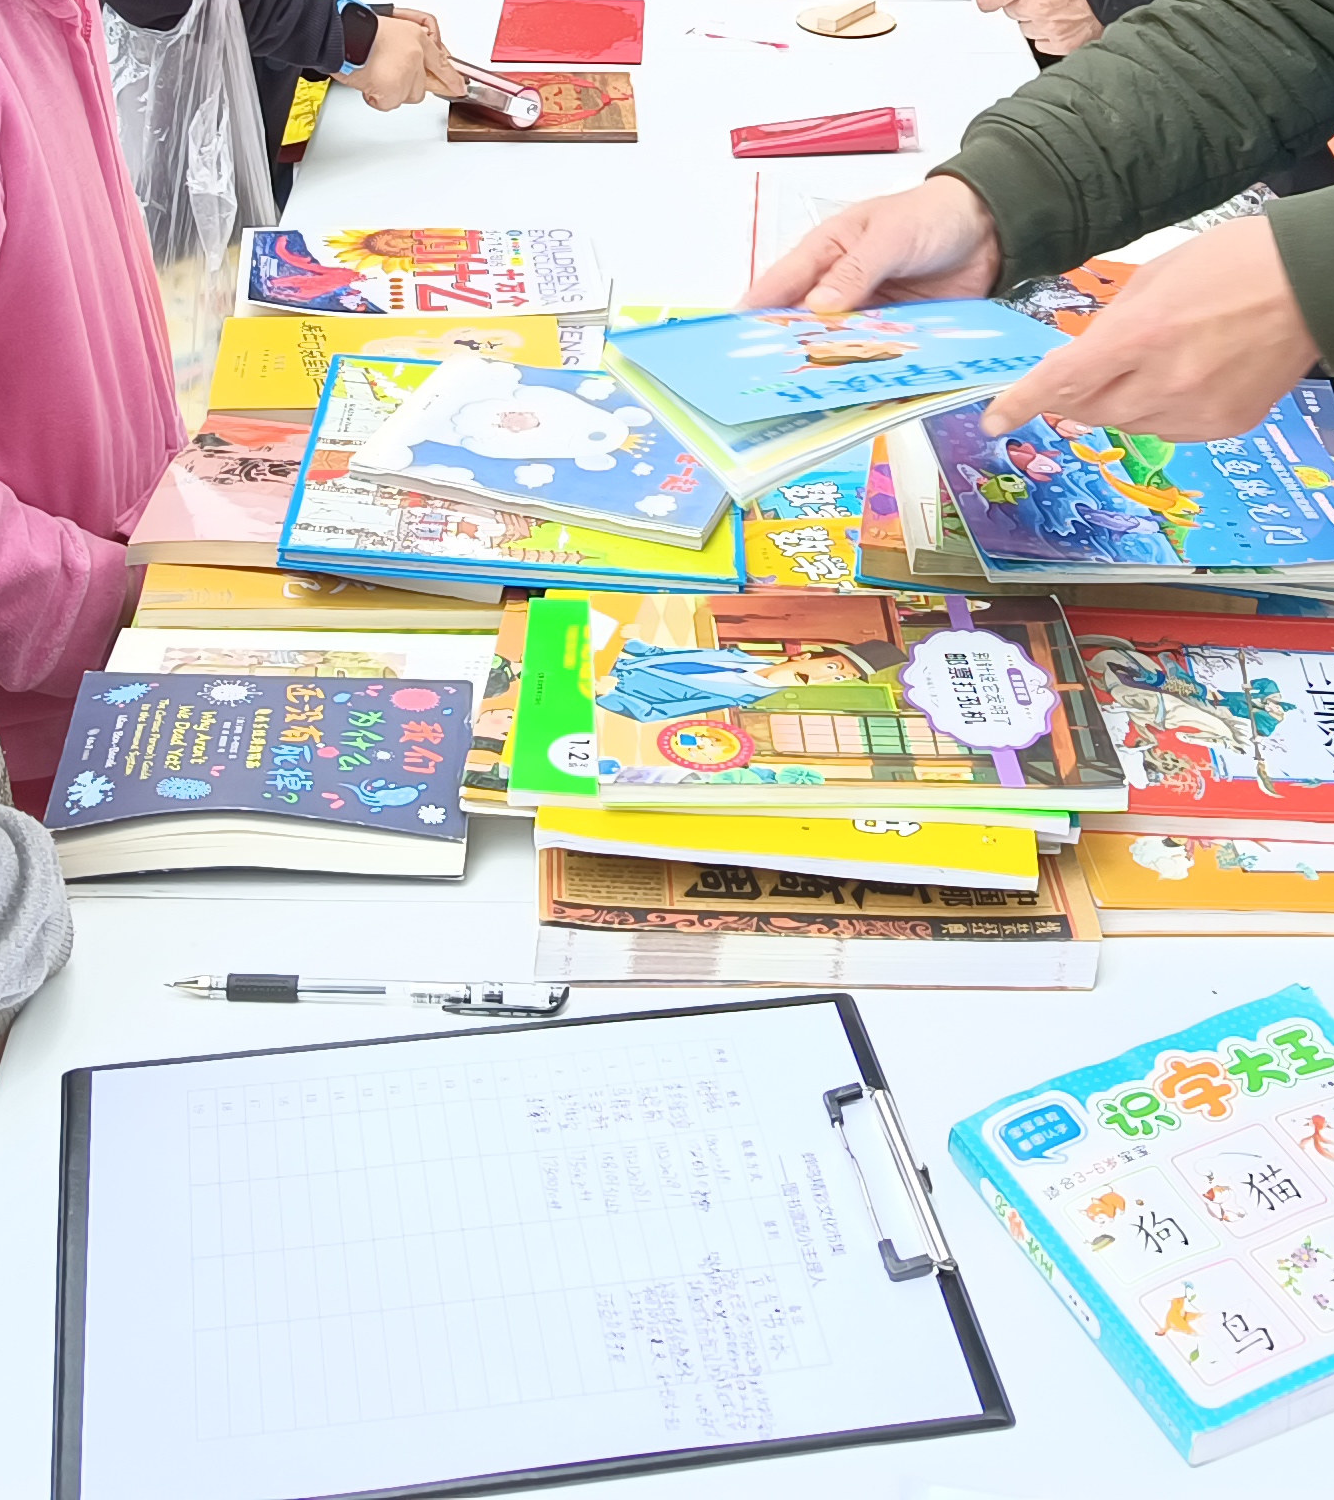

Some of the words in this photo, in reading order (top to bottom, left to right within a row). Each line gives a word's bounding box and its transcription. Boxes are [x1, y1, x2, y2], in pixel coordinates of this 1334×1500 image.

[412, 229, 492, 311] 为什么
[493, 268, 529, 306] 十万个
[528, 229, 559, 306] ENCYCLOPEDIA
[548, 228, 586, 303] CHILDREN'S
[177, 704, 195, 719] We
[945, 653, 987, 724] 邮票打孔机
[170, 722, 190, 746] Dead
[193, 711, 217, 731] Why
[338, 710, 386, 771] 为什么
[399, 721, 445, 775] 我们
[1243, 1164, 1302, 1211] 猫
[1129, 1211, 1189, 1254] 狗
[1222, 1311, 1275, 1355] 鸟
